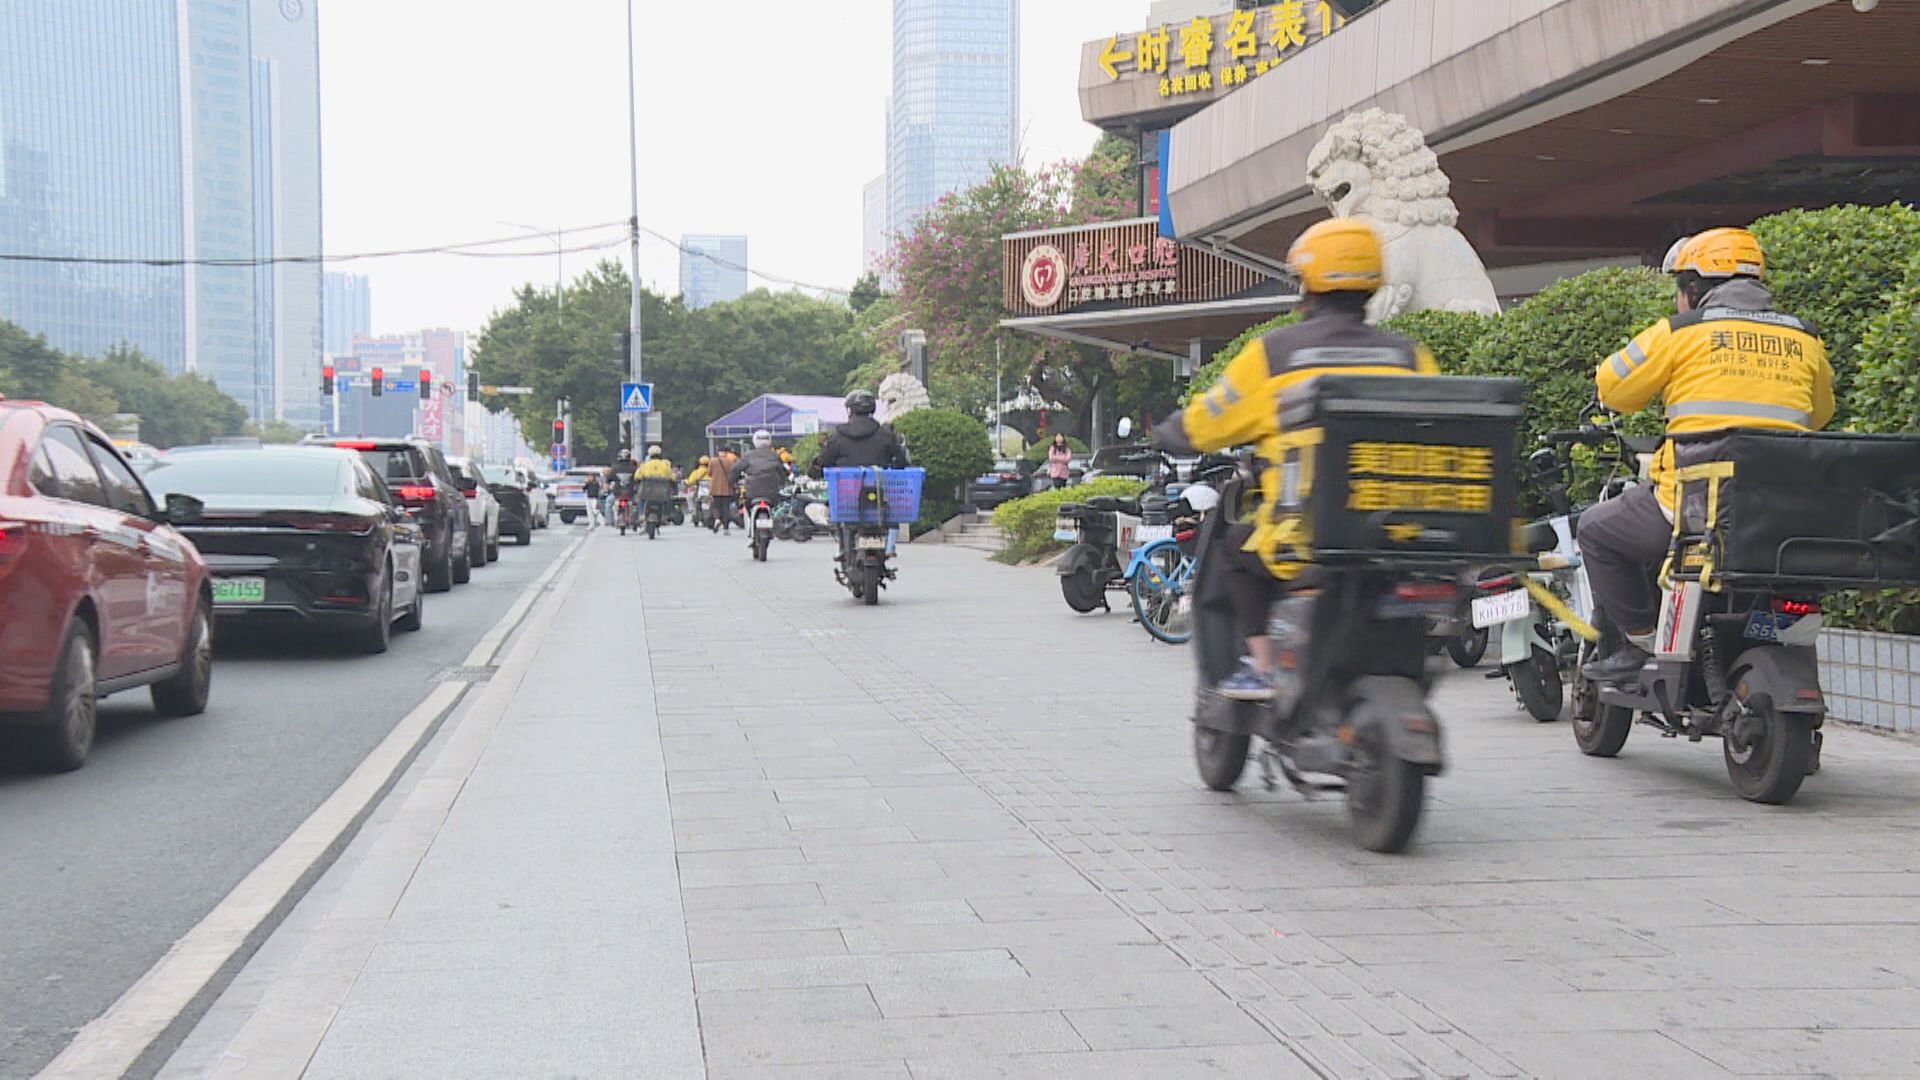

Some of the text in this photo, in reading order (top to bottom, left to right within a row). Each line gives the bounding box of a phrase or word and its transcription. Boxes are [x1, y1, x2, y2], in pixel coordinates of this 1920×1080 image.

[1158, 70, 1211, 97] 名表回收
[1219, 63, 1247, 86] 保养
[1107, 272, 1136, 283] DENTAL
[1138, 268, 1177, 280] HOSPITAL
[1710, 331, 1803, 362] 美团团购
